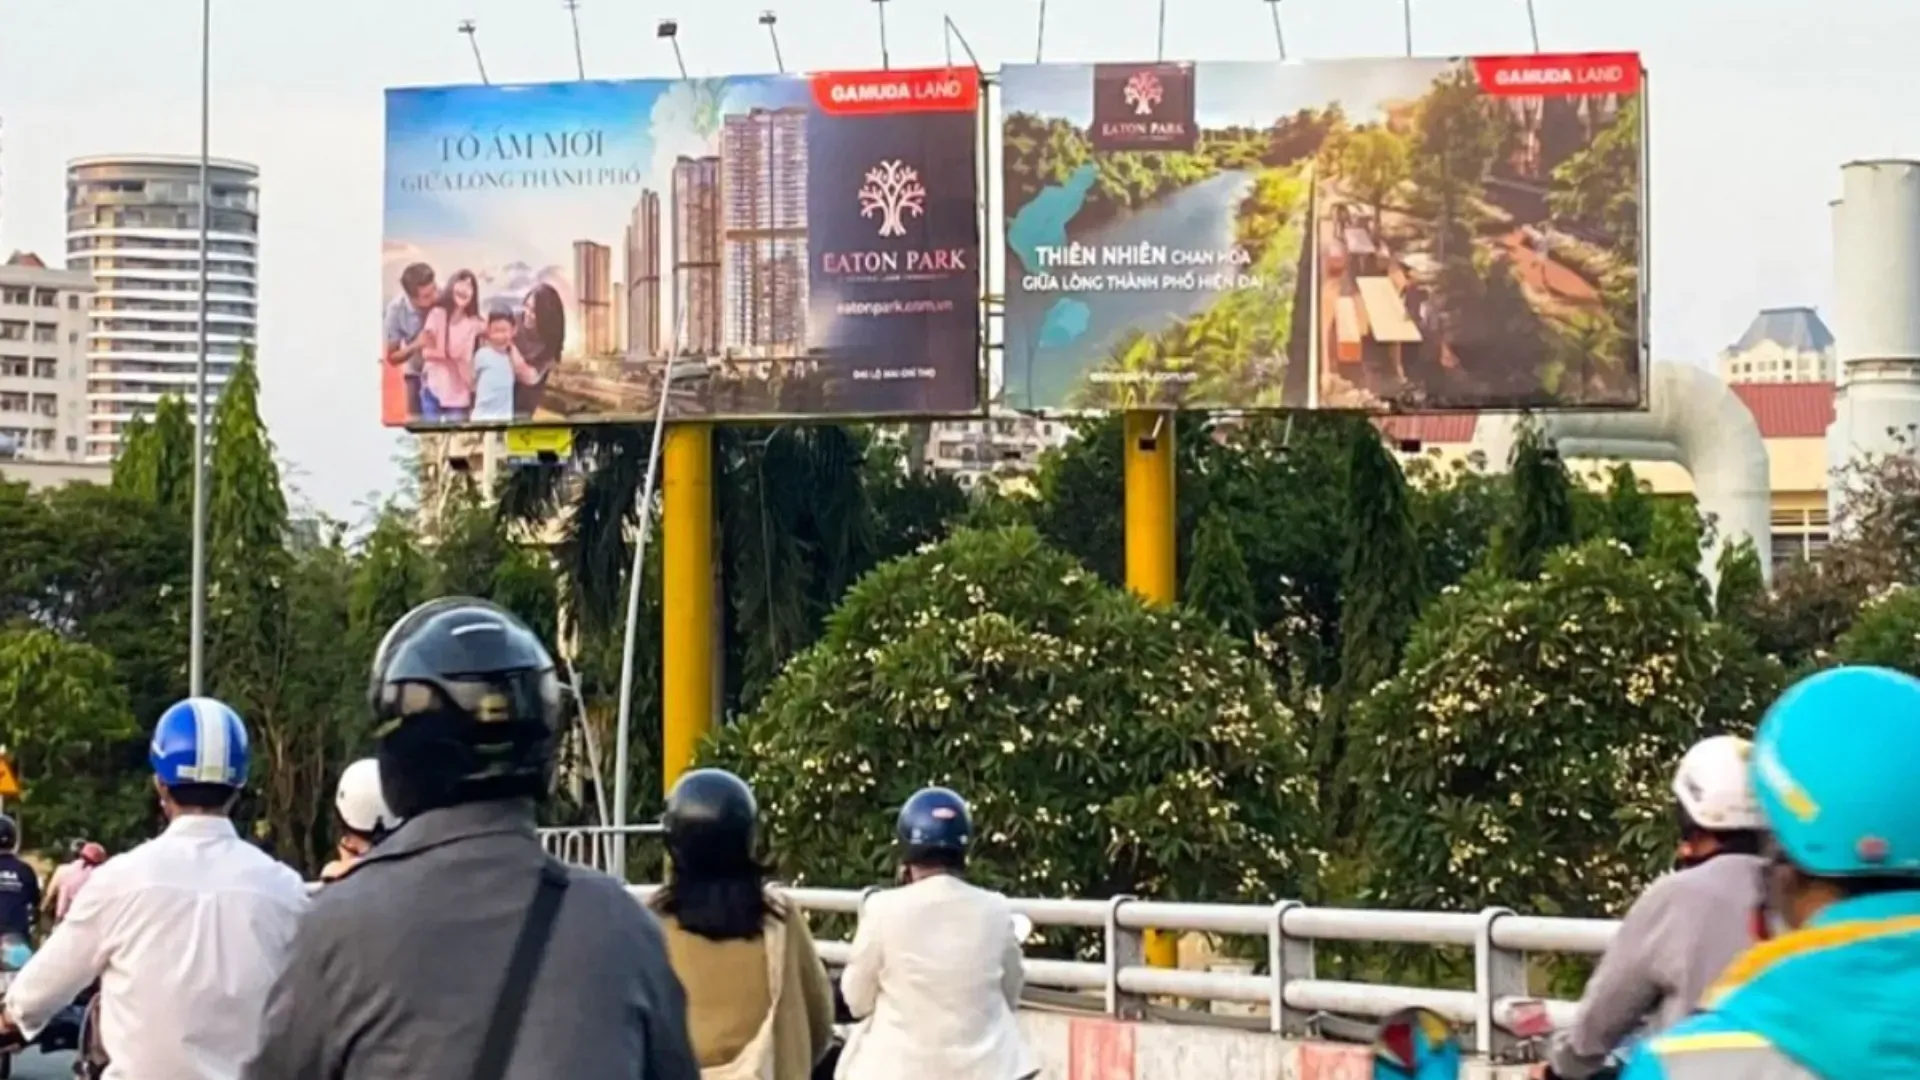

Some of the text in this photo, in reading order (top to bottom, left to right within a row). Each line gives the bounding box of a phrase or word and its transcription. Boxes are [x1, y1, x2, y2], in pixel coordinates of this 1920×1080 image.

[1495, 65, 1623, 85] GAMUDA LAND
[831, 80, 962, 102] GAMUDA LAND
[1102, 121, 1185, 136] EATON PARK
[823, 249, 967, 273] EATON PARK
[1034, 240, 1097, 266] THIÊN
[1102, 240, 1167, 266] NHIÊN
[1171, 248, 1214, 265] CHAN
[1021, 271, 1059, 292] GIỮA
[1061, 271, 1104, 292] LÒNG
[1107, 270, 1158, 291] THÀNH
[1162, 269, 1195, 291] PHỐ
[837, 299, 954, 317] eatonpark.com.vn
